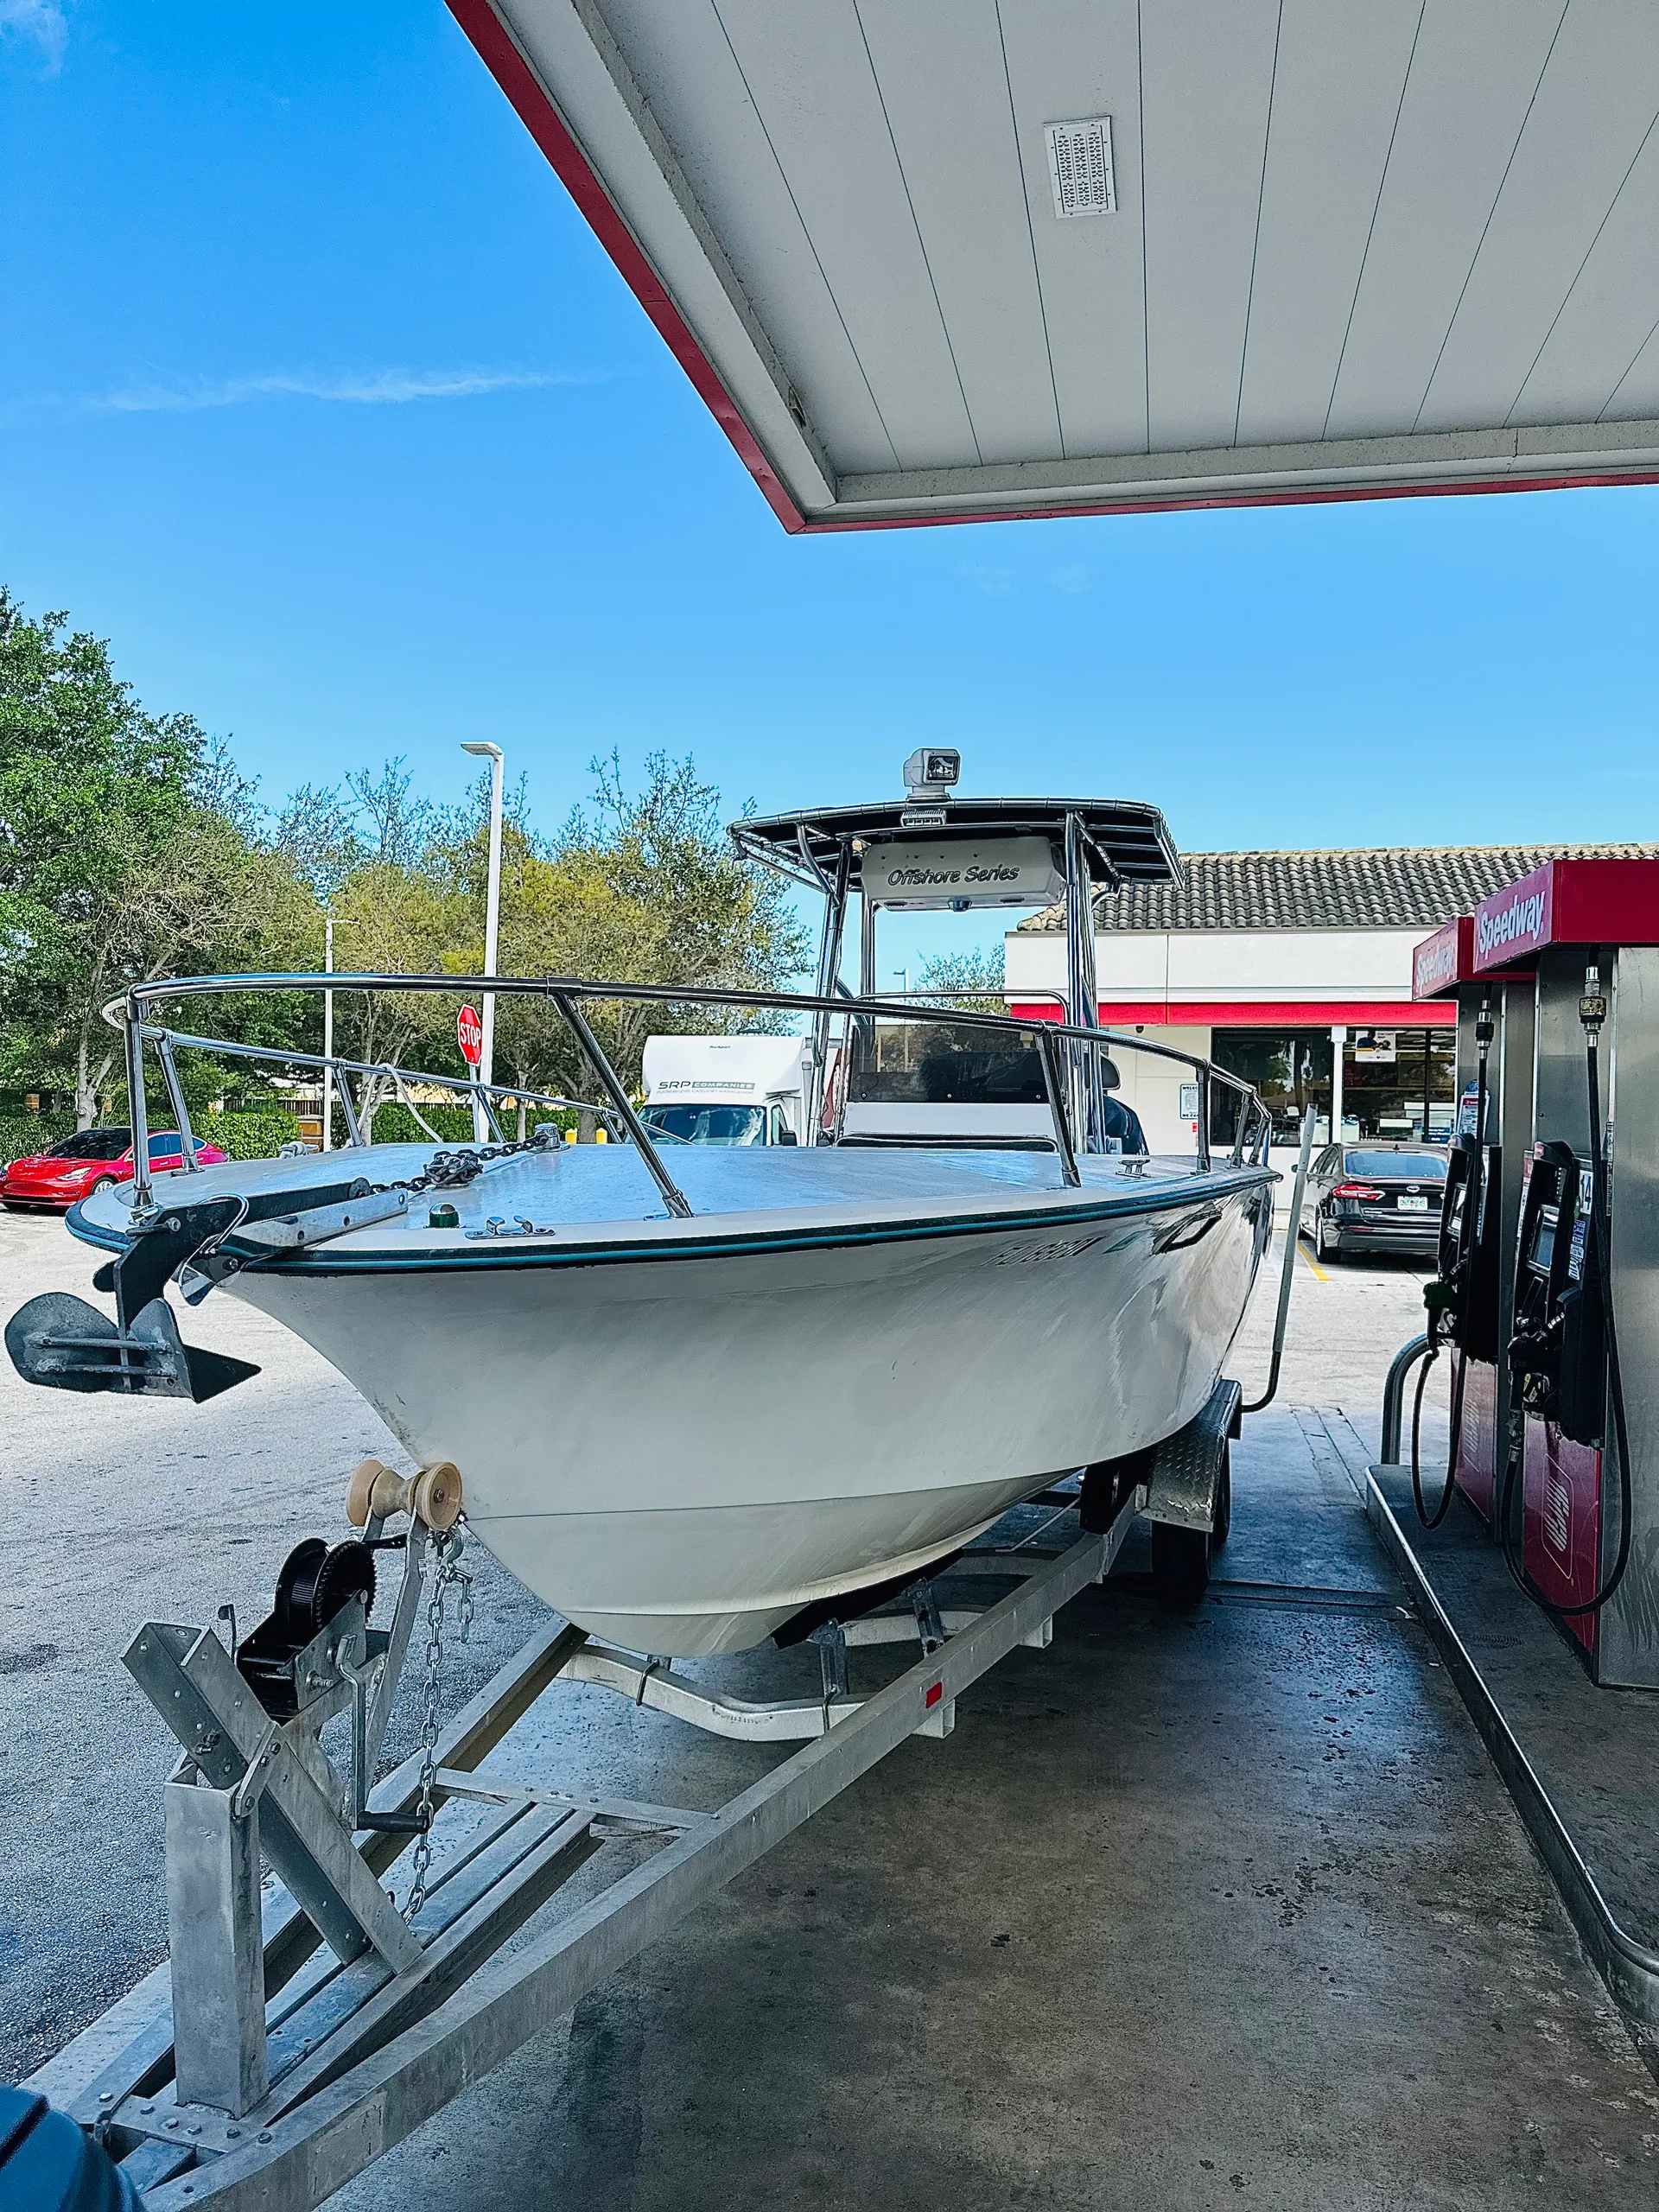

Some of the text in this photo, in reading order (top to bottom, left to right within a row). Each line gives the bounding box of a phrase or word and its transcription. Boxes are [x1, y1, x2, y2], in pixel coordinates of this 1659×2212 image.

[887, 864, 1020, 886] Offshore Series
[1479, 891, 1545, 961] Speedway
[1415, 942, 1454, 997] Speedway
[461, 1021, 481, 1049] STOP
